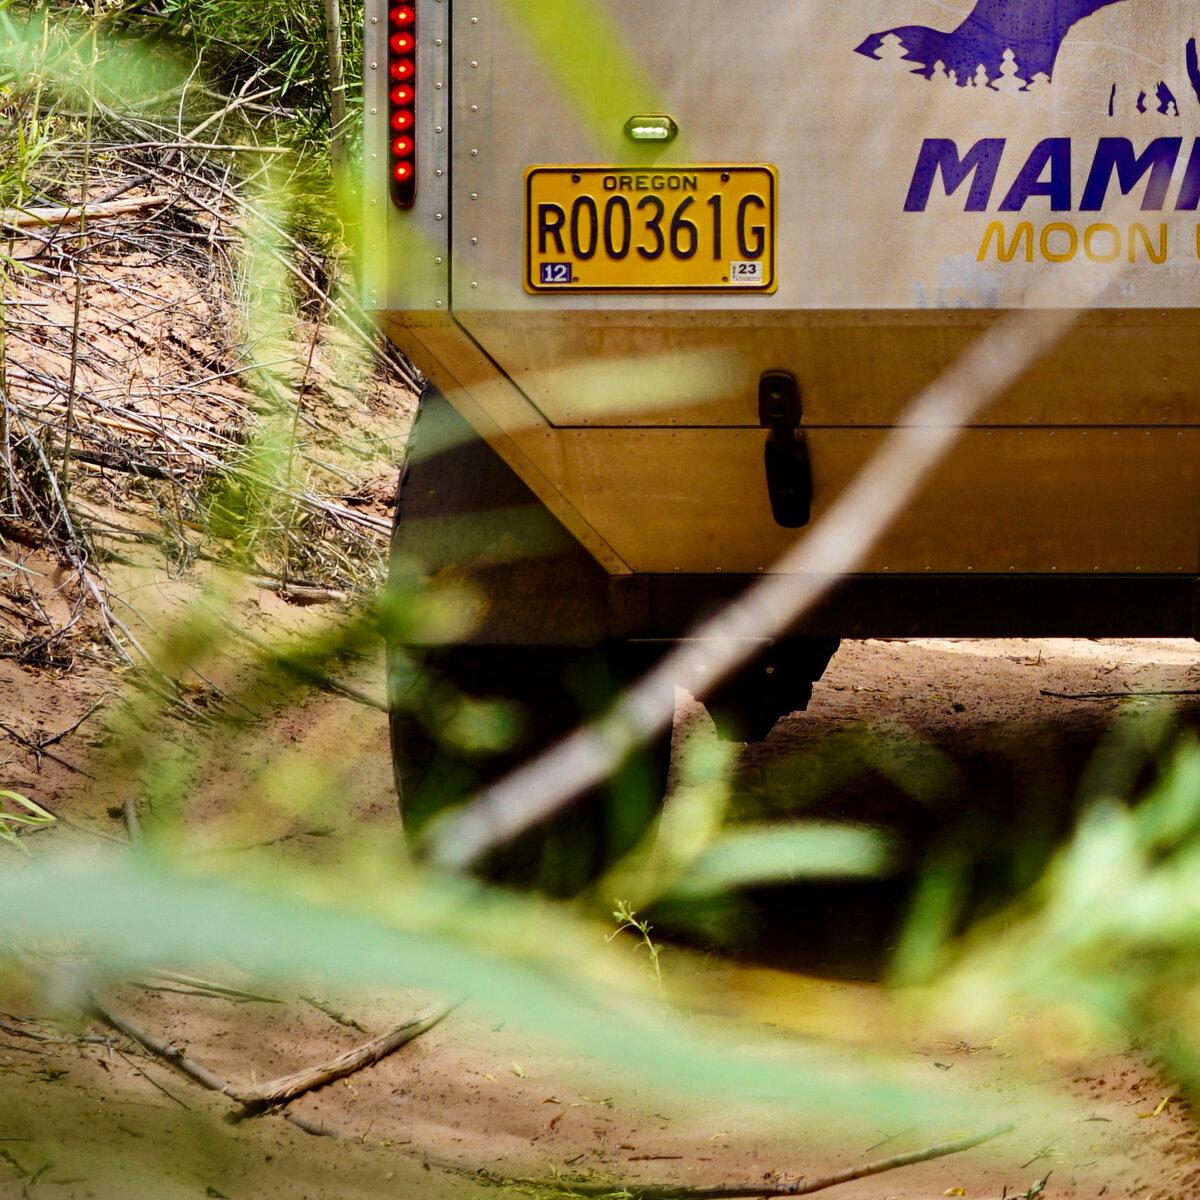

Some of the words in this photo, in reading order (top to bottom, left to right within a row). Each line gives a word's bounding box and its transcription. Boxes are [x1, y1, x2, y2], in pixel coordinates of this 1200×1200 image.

[603, 175, 698, 191] OREGON
[538, 194, 765, 260] R00361G
[976, 221, 1168, 263] MOON
[544, 264, 567, 282] 12
[739, 263, 756, 274] 23
